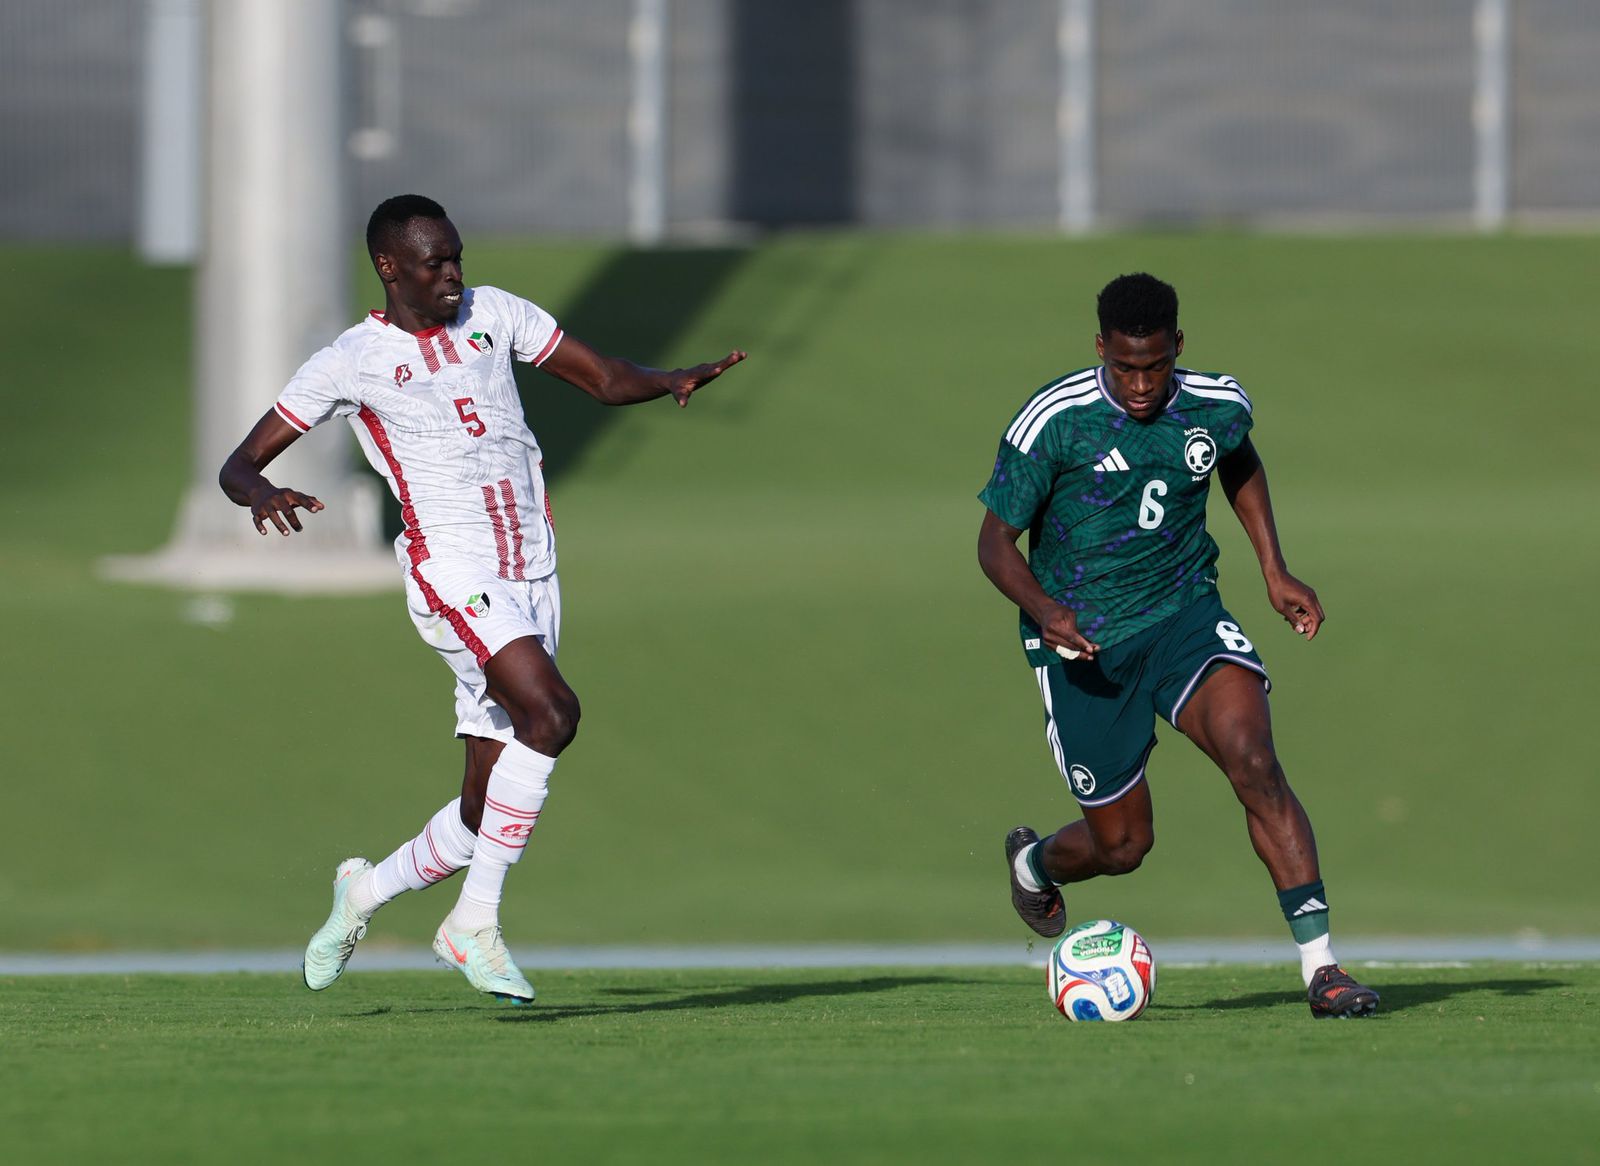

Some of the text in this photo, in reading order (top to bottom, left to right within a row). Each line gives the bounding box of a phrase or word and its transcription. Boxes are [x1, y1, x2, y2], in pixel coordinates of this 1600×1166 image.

[453, 397, 487, 437] 5
[1138, 479, 1168, 530] 6
[1215, 620, 1253, 653] 6
